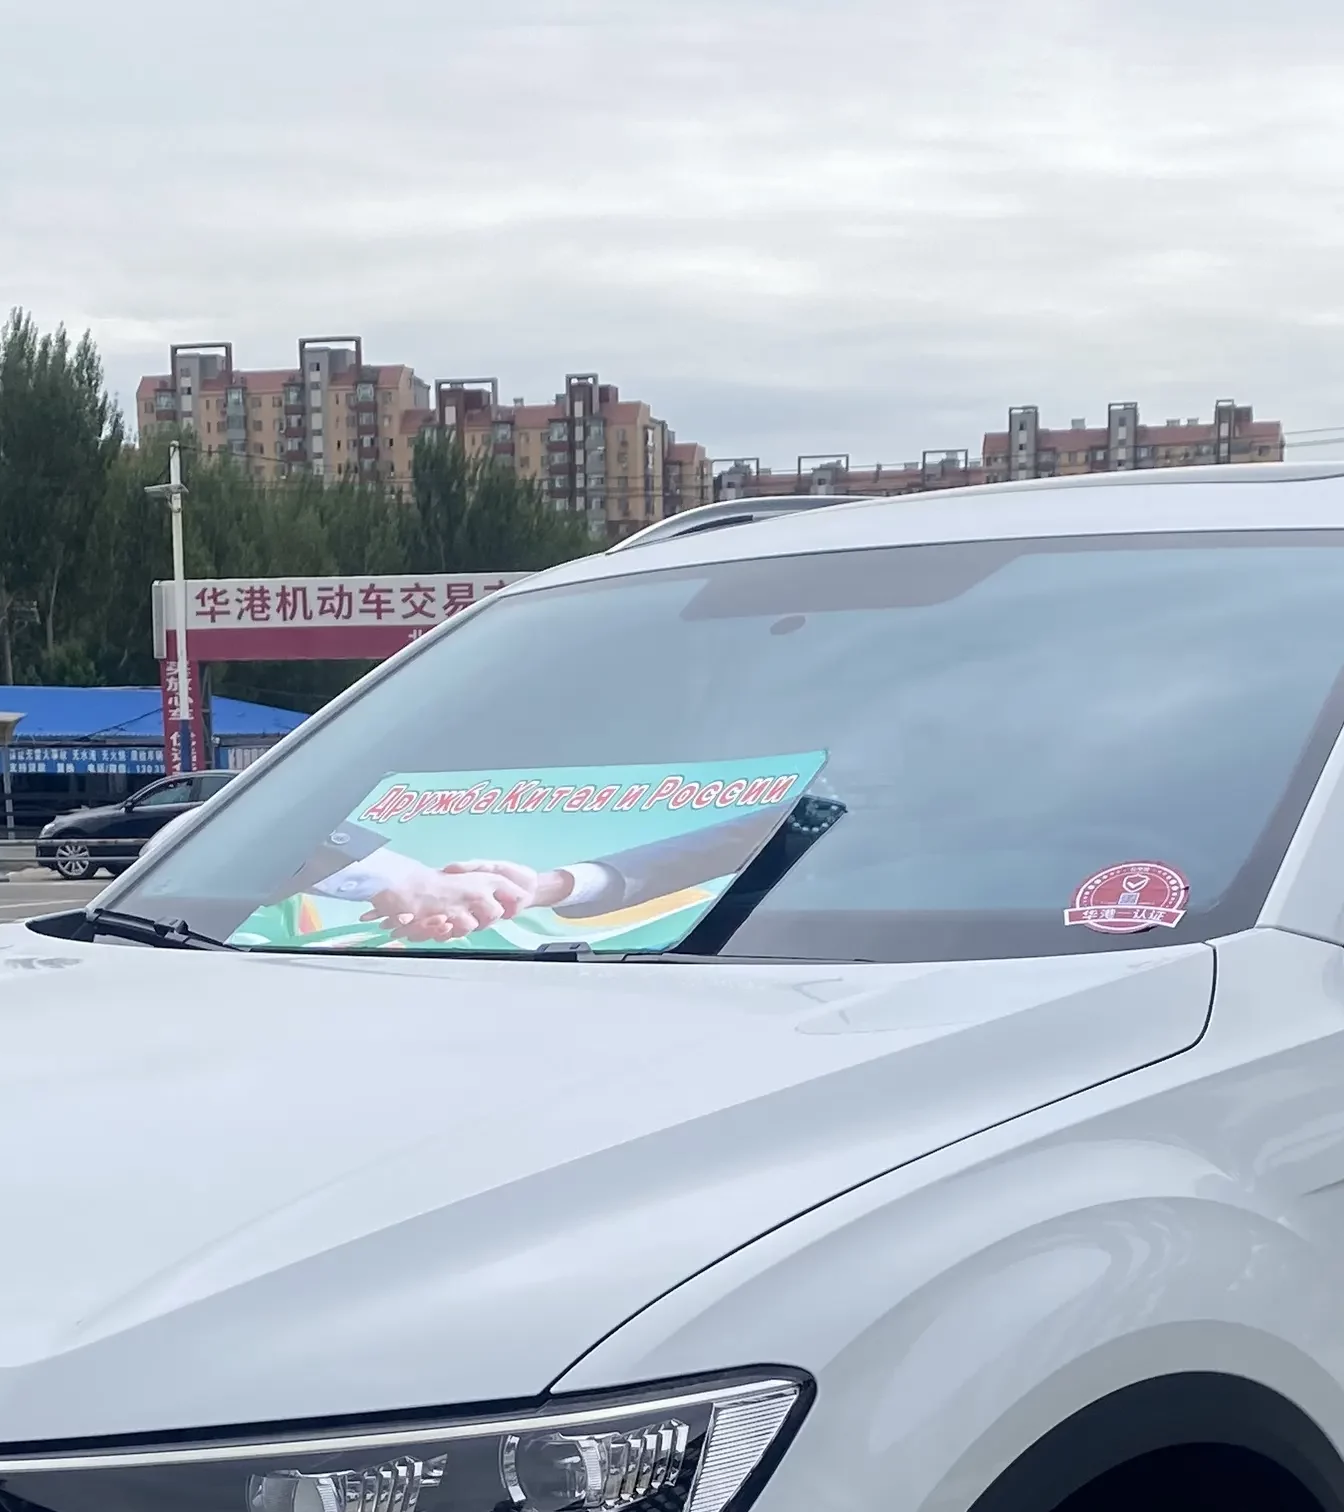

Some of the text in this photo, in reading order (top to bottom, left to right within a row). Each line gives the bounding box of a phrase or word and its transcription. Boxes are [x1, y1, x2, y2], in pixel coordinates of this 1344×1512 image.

[358, 774, 799, 823] Дружба Китая и России
